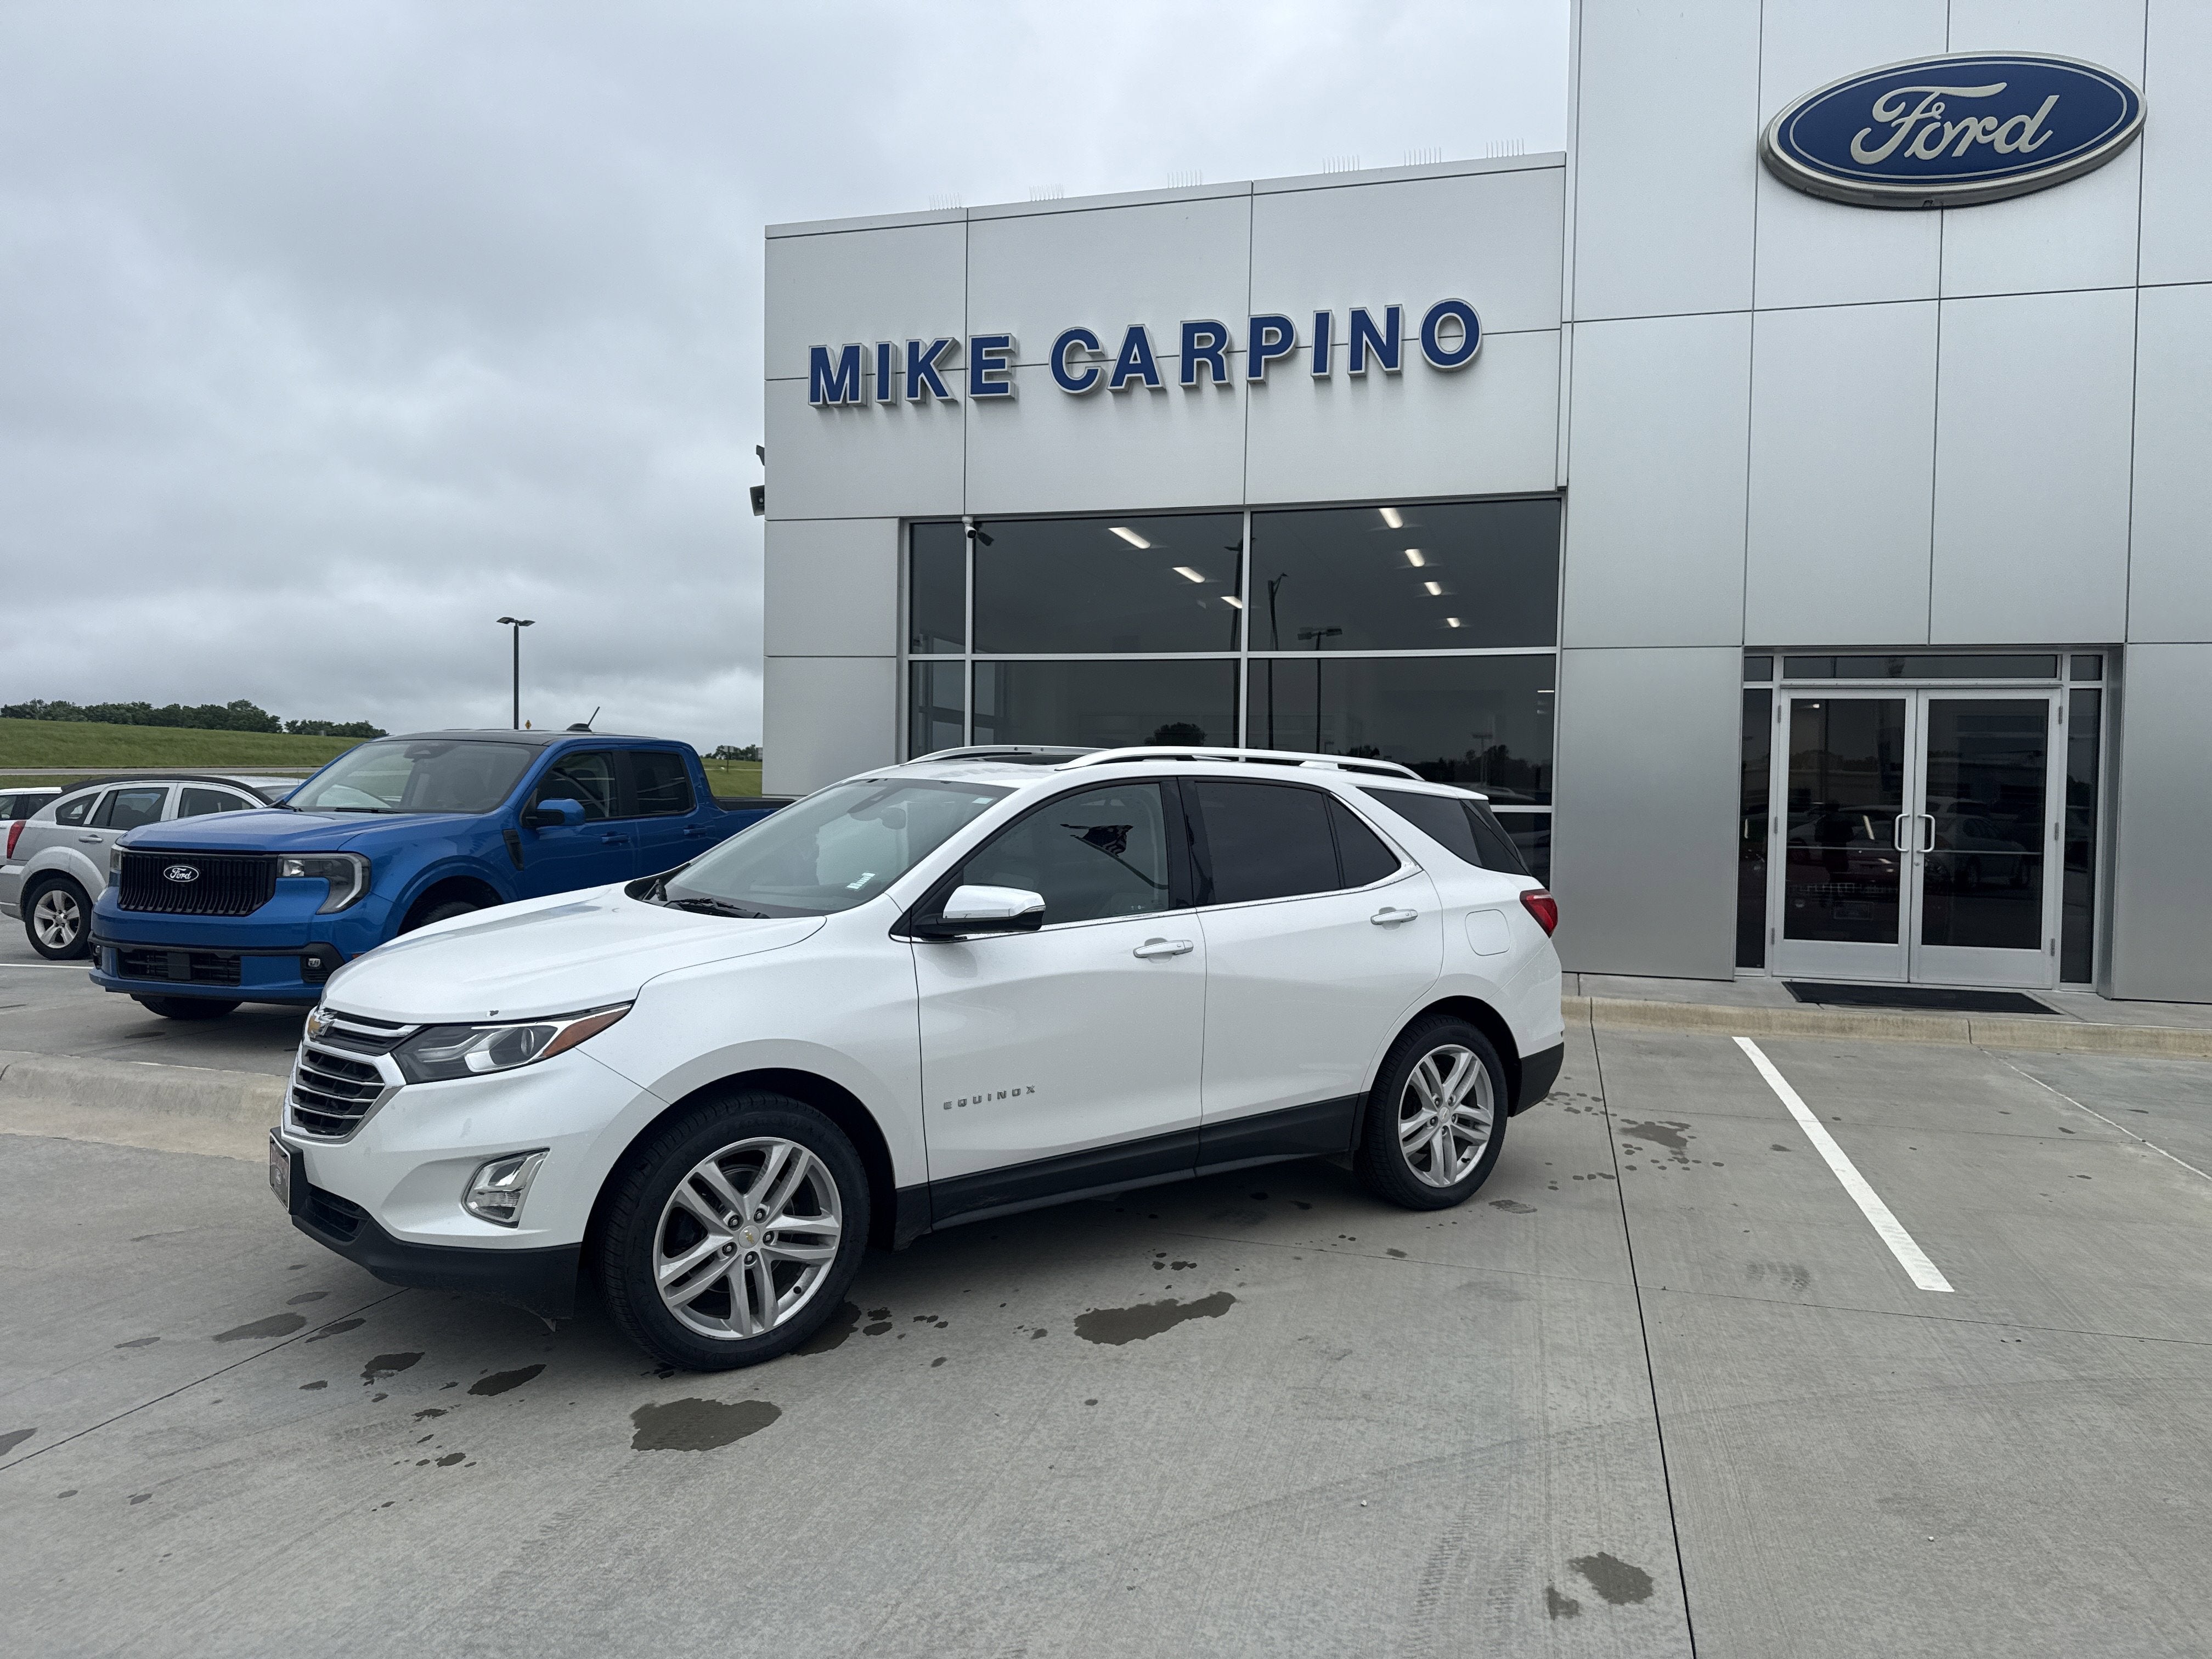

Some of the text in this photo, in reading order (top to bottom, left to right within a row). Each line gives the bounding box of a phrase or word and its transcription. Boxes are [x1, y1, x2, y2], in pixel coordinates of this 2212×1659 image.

[1849, 82, 2060, 165] Ford
[809, 297, 1482, 408] MIKE CARPINO
[170, 867, 192, 879] Ford
[943, 1084, 1036, 1110] EQUINOX
